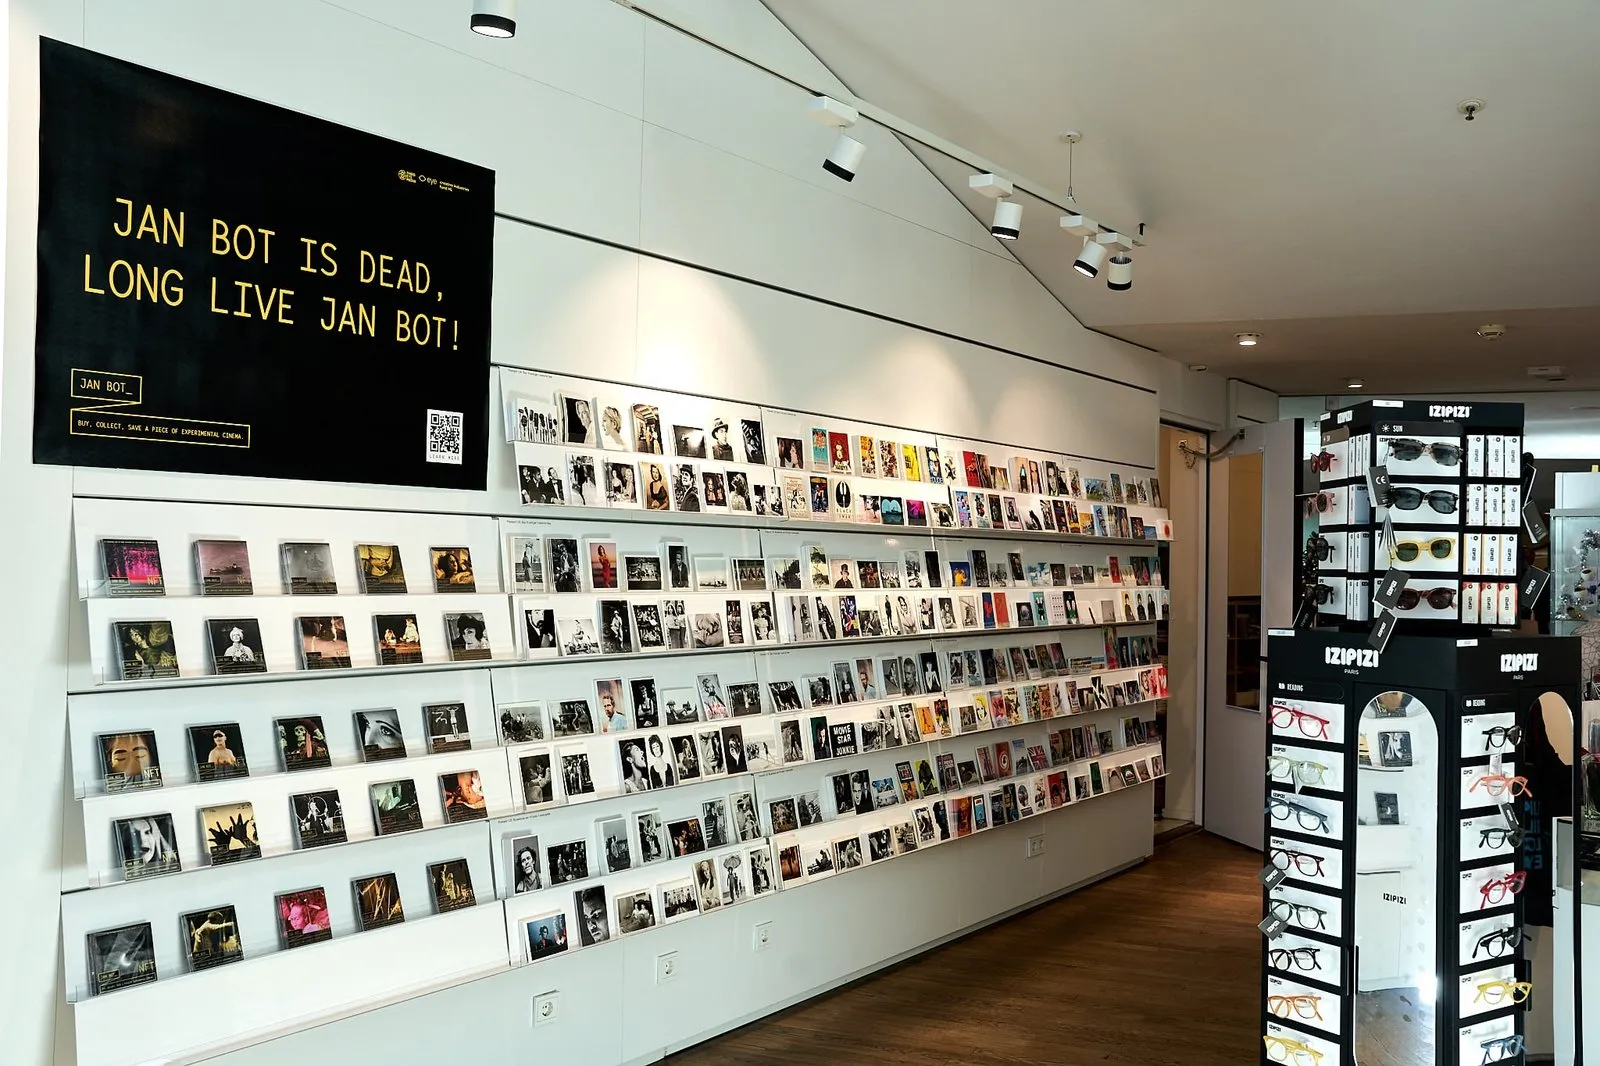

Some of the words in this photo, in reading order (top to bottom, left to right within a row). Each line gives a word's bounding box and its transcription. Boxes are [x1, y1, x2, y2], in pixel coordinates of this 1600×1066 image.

[114, 198, 184, 247] JAN
[212, 219, 275, 263] BOT
[301, 238, 338, 276] IS
[360, 250, 442, 301] DEAD,
[85, 254, 183, 306] LONG
[211, 277, 294, 324] LIVE
[321, 297, 375, 337] JAN
[397, 310, 457, 350] BOT!
[80, 378, 100, 390] JAN
[1429, 405, 1470, 418] IZIPIZI
[127, 423, 142, 432] SAVE
[151, 426, 168, 434] PIECE
[181, 429, 219, 438] EXPERIMENTAL
[222, 431, 243, 440] CINEMA.
[1325, 646, 1379, 668] IZIPIZI
[1501, 653, 1538, 672] IZIPIZI
[833, 724, 851, 735] MOVIE
[837, 733, 851, 744] STAR
[1383, 893, 1406, 904] IZIPIZI
